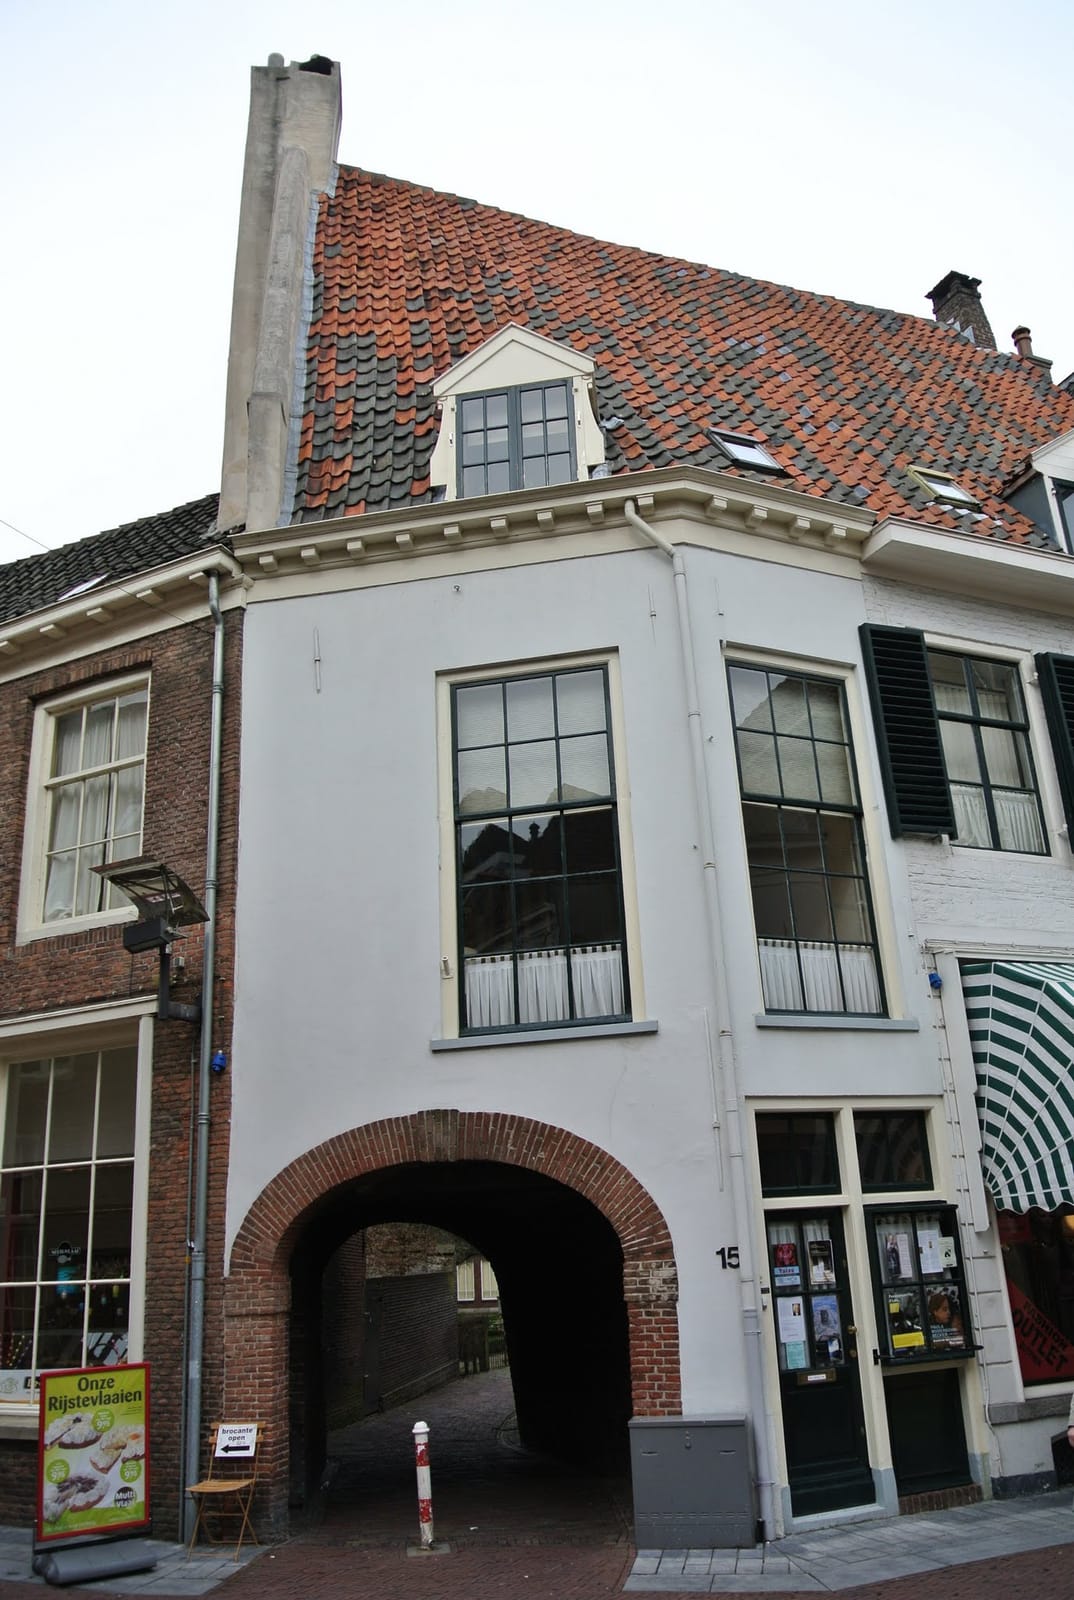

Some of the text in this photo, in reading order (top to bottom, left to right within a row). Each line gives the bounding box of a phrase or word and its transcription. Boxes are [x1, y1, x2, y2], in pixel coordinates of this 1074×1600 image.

[715, 1246, 740, 1270] 15
[1013, 1308, 1068, 1372] OUTLET
[77, 1377, 115, 1392] Onze
[48, 1389, 142, 1414] Rijstevlaaien
